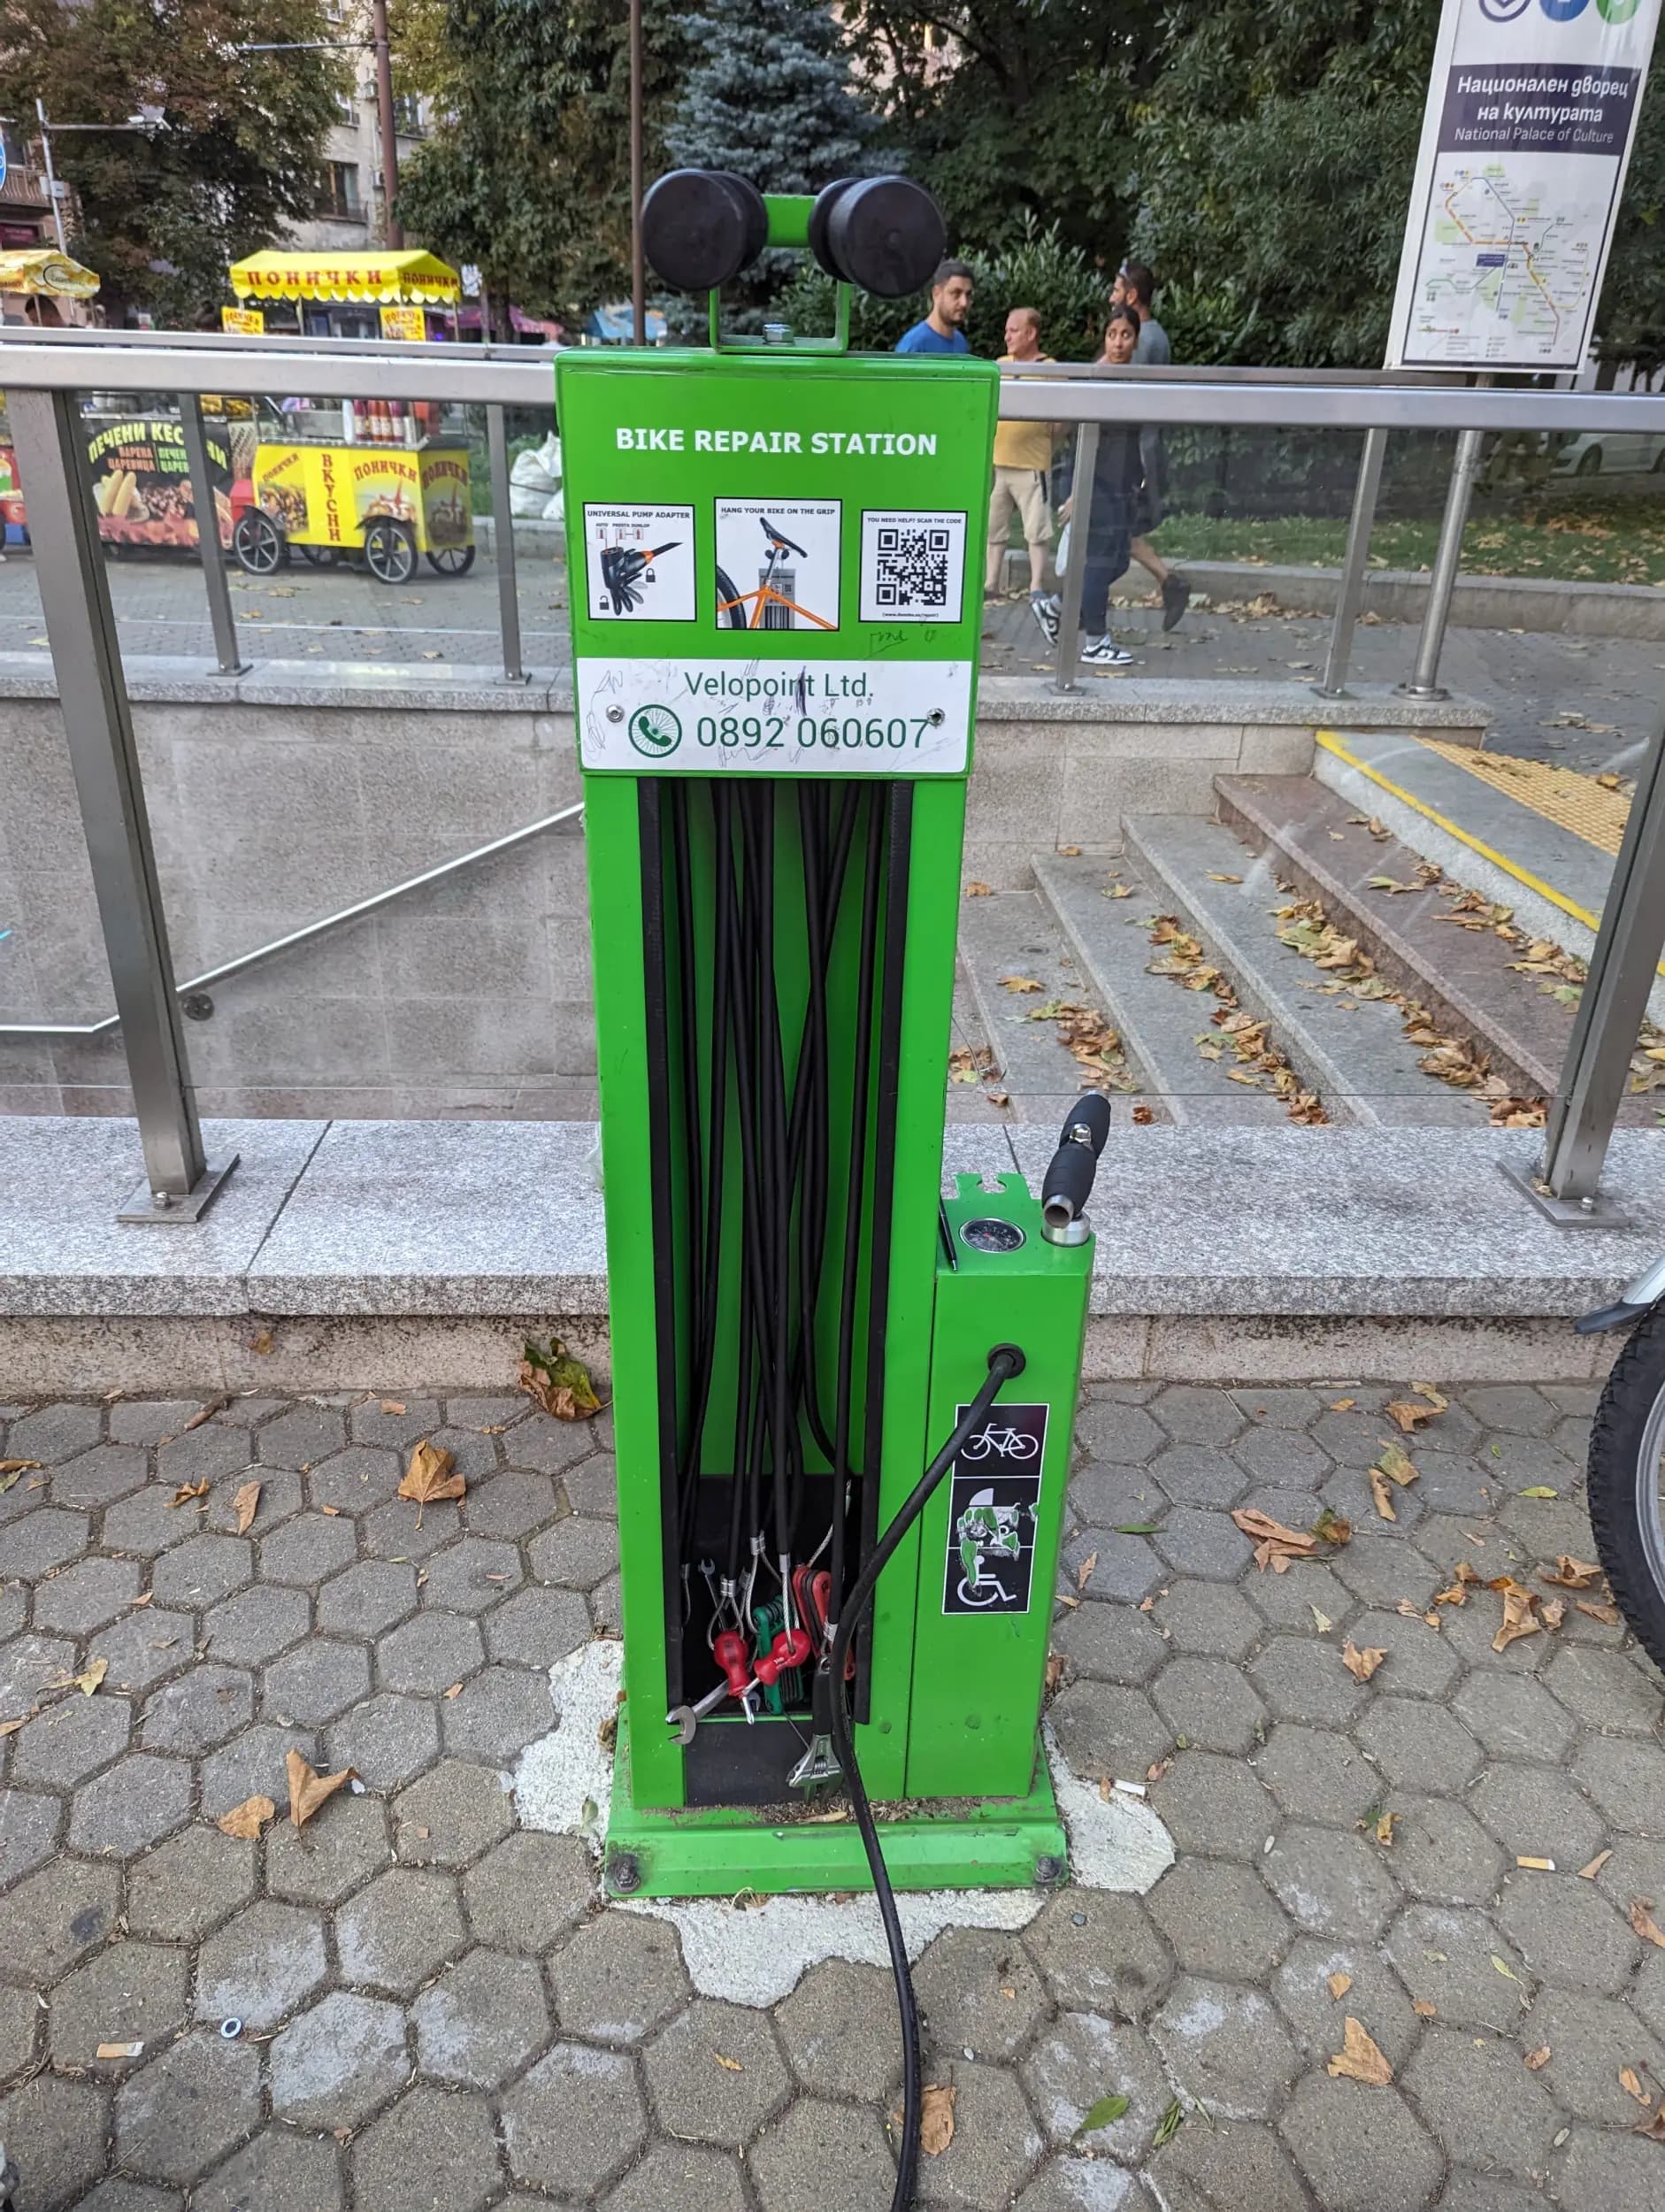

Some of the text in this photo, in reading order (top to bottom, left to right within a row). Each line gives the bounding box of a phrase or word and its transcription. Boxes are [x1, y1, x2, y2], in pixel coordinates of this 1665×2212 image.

[1457, 75, 1629, 98] Национален дворец
[1477, 102, 1603, 125] на културата
[1454, 127, 1614, 143] National Palace of Culture
[247, 270, 383, 286] ПОНИЧКИ
[403, 273, 458, 288] ПОНИЧКИ
[88, 423, 146, 464] ПЕЧЕНИ
[617, 428, 937, 455] BIKE REPAIR STATION
[354, 459, 418, 483] ПОНИЧКИ
[684, 671, 874, 702] Velopoint Ltd.
[697, 717, 928, 749] 0892 060607
